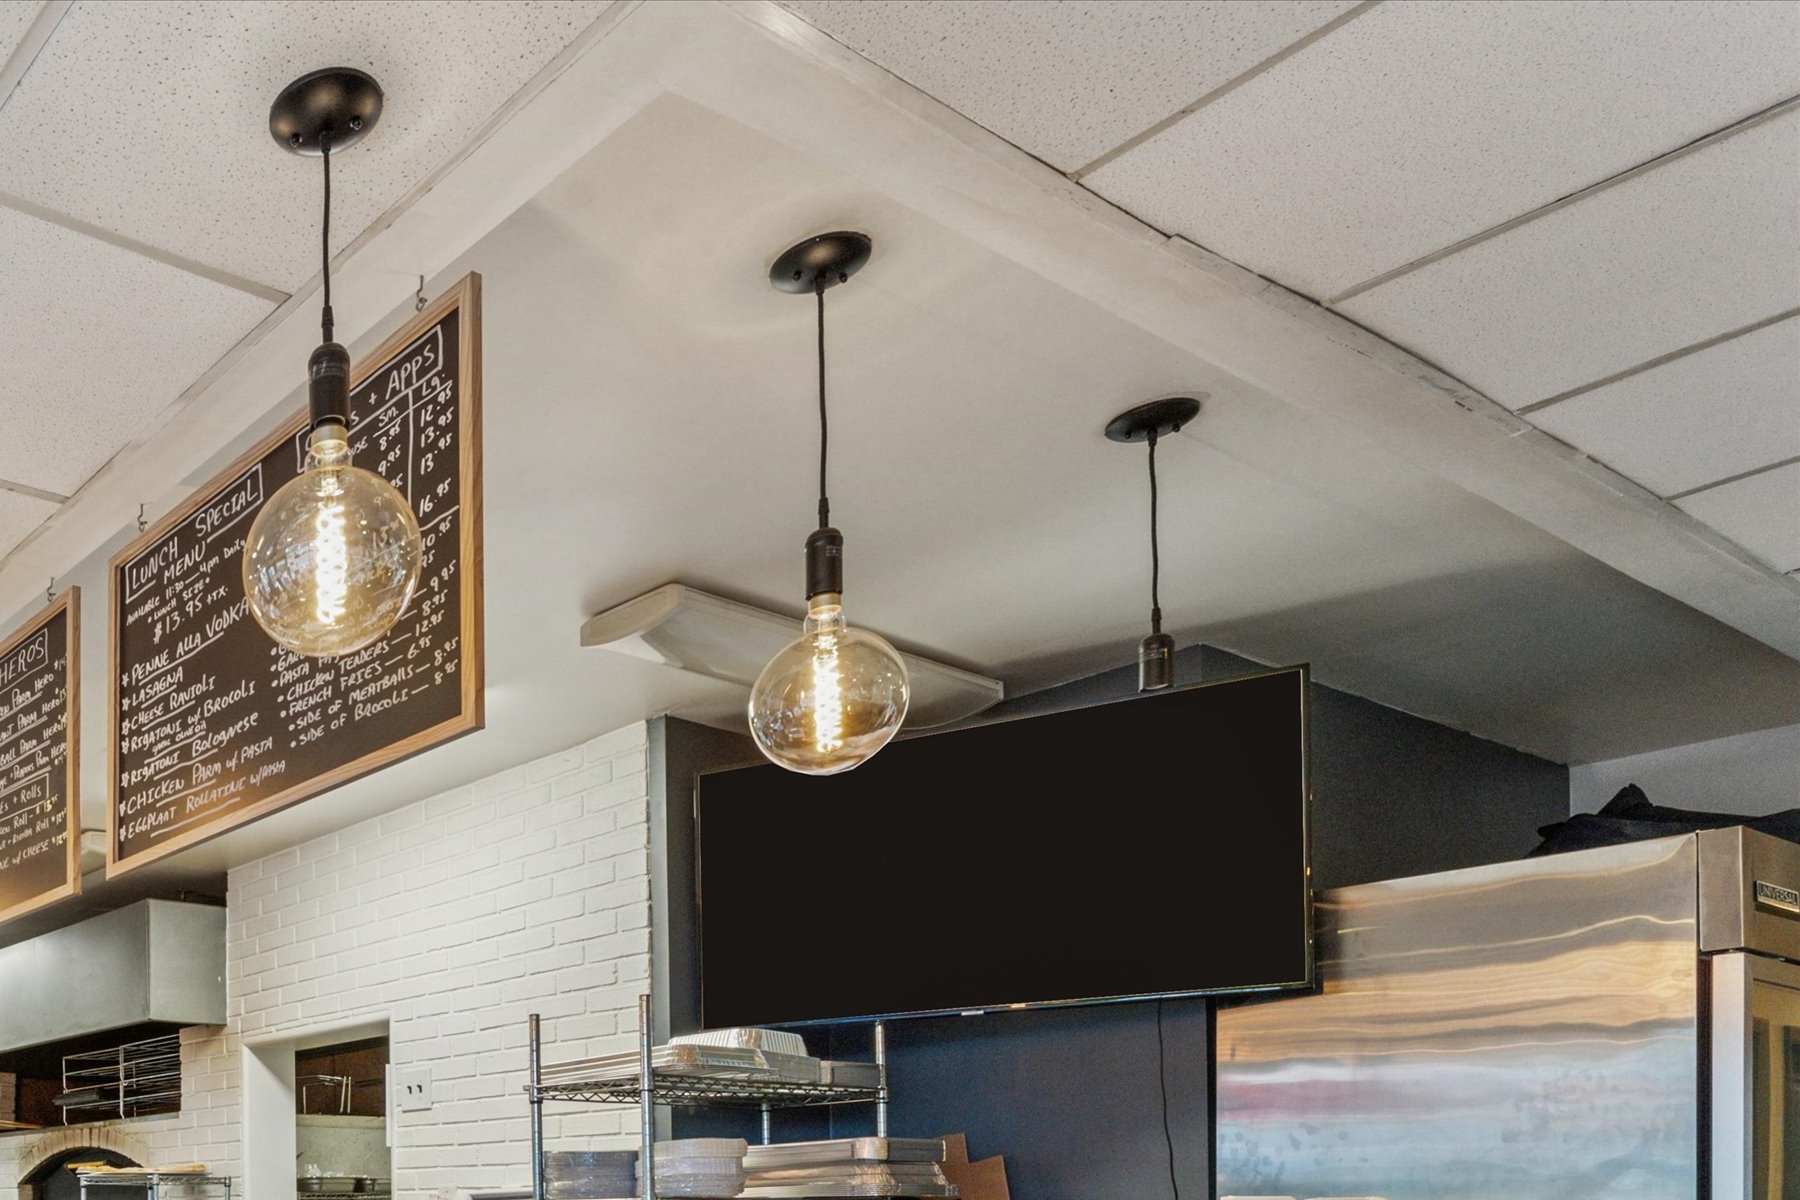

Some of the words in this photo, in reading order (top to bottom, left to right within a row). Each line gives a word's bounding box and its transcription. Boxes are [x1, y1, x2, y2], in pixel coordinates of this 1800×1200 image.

[385, 344, 434, 400] APPS
[420, 478, 451, 517] 16.95
[132, 536, 179, 590] LUNCH
[195, 479, 258, 537] SPECIAL
[164, 541, 205, 585] MENU
[126, 596, 160, 626] AVAILABLE
[0, 637, 44, 687] HEROS
[132, 649, 170, 686] PENNE
[176, 633, 201, 658] ALLA
[280, 662, 309, 687] PASTA
[131, 702, 164, 729] CHEESE
[170, 674, 216, 710] RAVIOLI
[132, 666, 183, 706] LASAGNA
[287, 670, 334, 700] CHICKEN
[289, 685, 332, 716] FRENCH
[340, 661, 382, 691] FRIES
[296, 709, 321, 729] SIDE
[328, 700, 342, 714] OF
[299, 725, 324, 745] SIDE
[331, 713, 347, 729] OF
[127, 778, 184, 814] CHICKEN
[241, 736, 273, 766] PASTA
[22, 839, 49, 859] CHEESE
